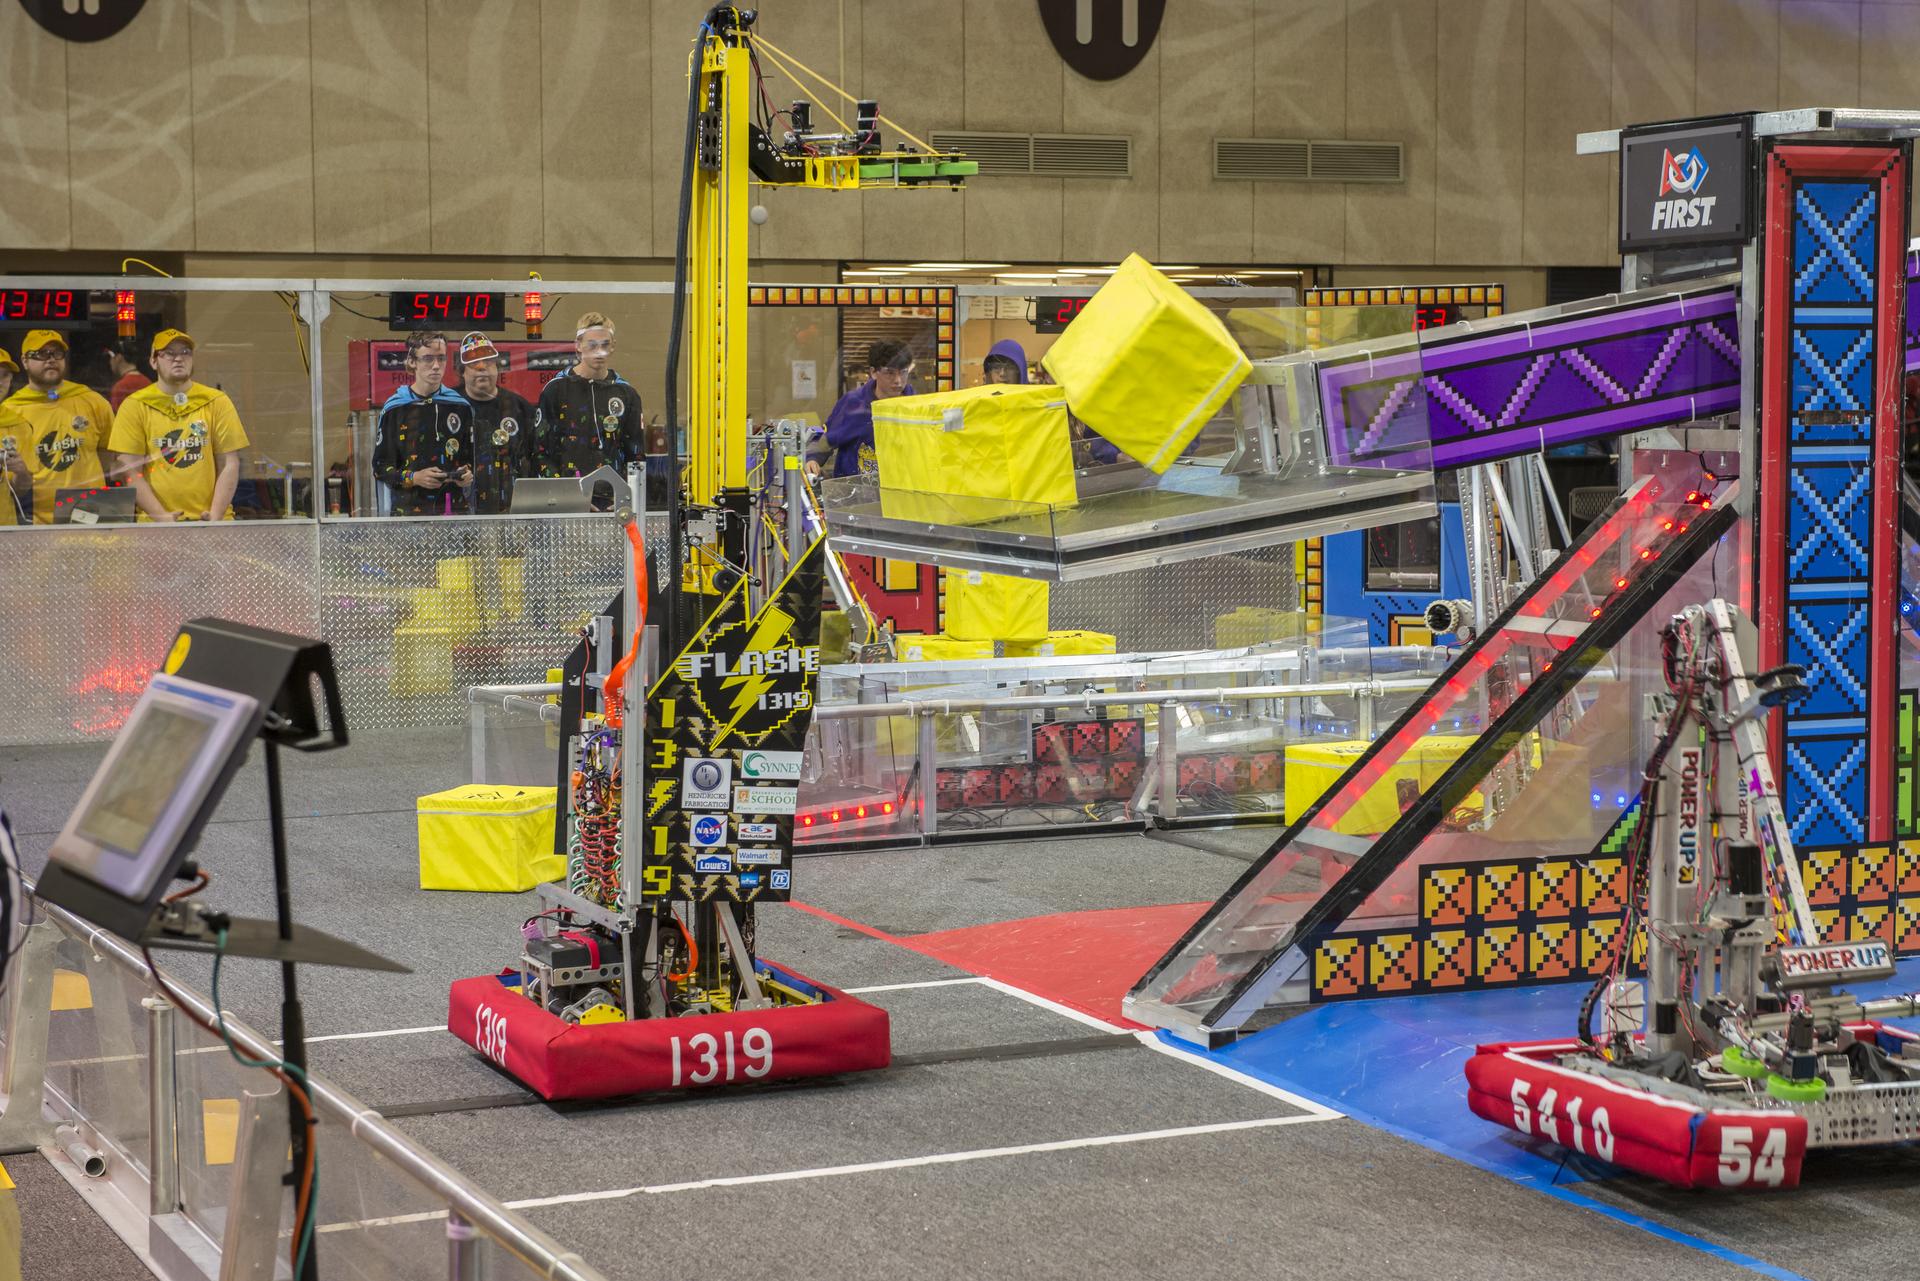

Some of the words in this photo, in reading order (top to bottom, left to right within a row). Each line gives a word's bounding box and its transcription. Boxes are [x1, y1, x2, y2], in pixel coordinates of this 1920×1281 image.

[0, 291, 73, 317] 1319
[413, 294, 490, 318] 5410
[154, 436, 206, 448] FLASH
[680, 648, 819, 678] FLASH
[758, 691, 809, 711] 1319
[684, 800, 729, 808] FABRICATION
[1680, 751, 1698, 828] POWER
[1680, 832, 1696, 864] UP
[1782, 949, 1857, 972] POWER
[1857, 947, 1886, 966] UP
[475, 1003, 507, 1067] 1319
[670, 1028, 773, 1086] 1319
[1511, 1078, 1614, 1162] 5410
[1718, 1126, 1787, 1187] 54
